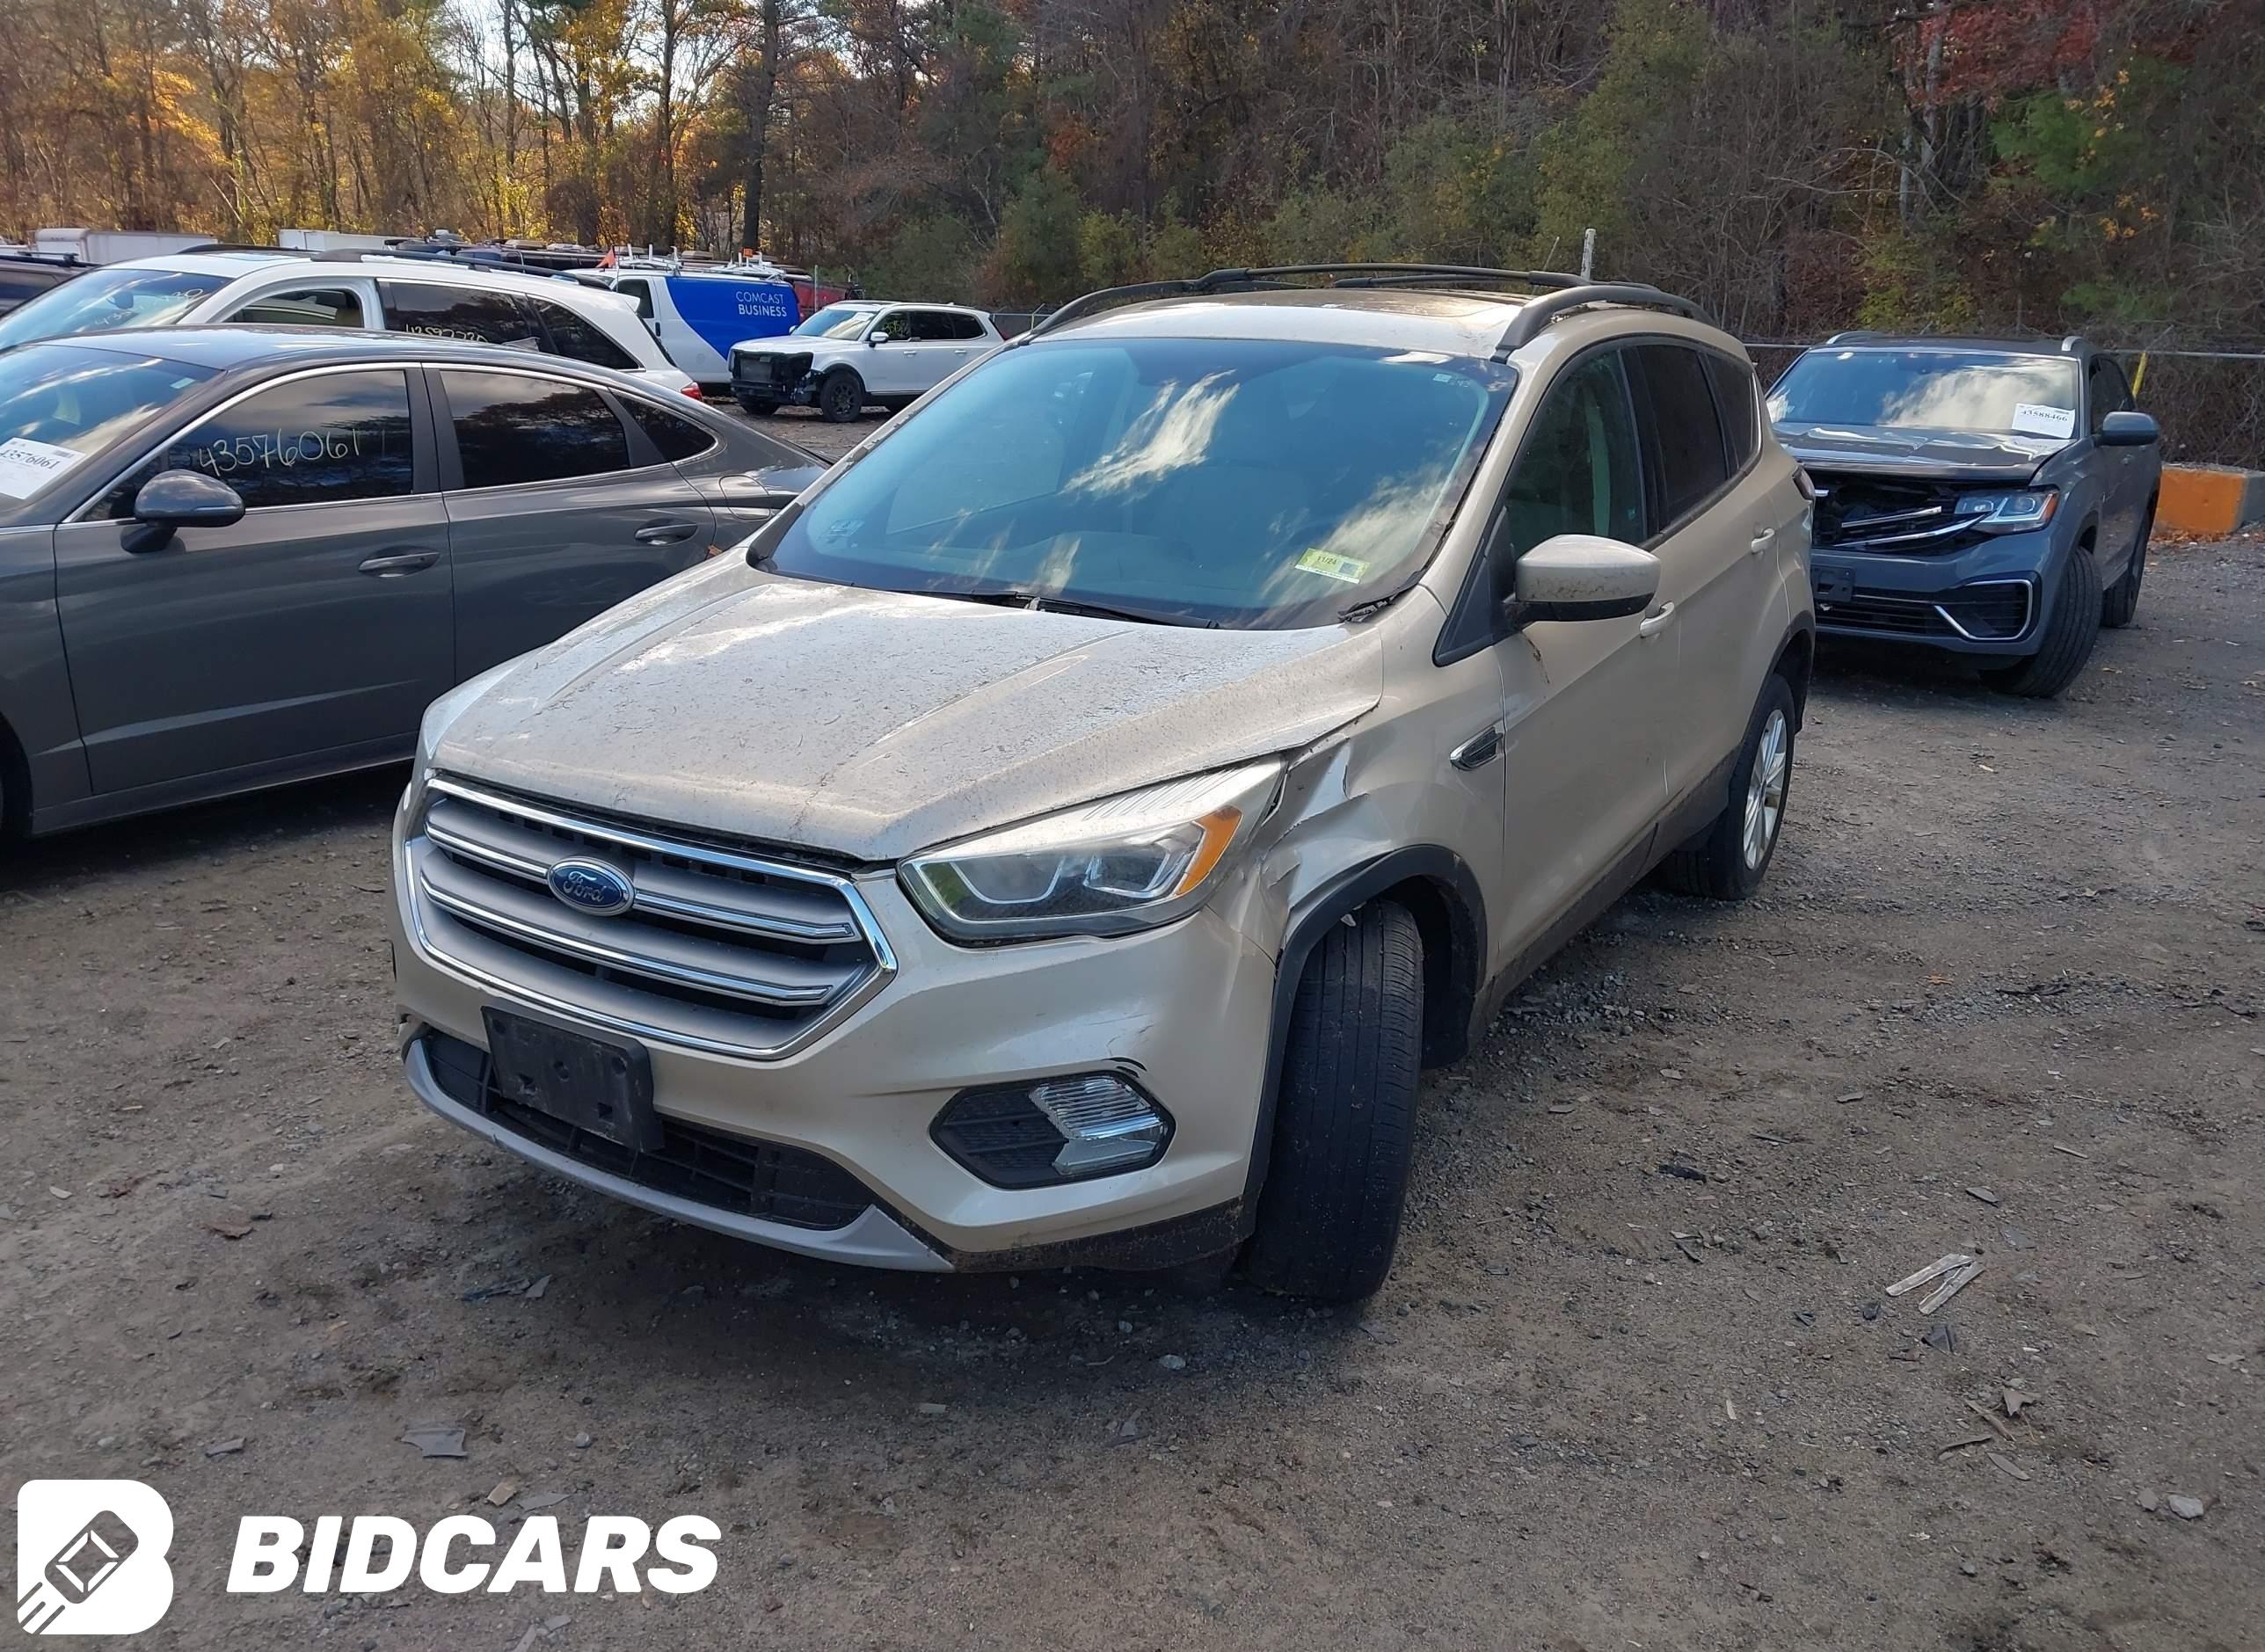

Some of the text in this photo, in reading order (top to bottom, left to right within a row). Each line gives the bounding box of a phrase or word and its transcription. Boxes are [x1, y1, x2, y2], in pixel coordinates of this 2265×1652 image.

[735, 291, 783, 303] COMCAST
[739, 304, 787, 317] BUSINESS
[199, 428, 360, 477] 43576061
[563, 870, 605, 902] Ford
